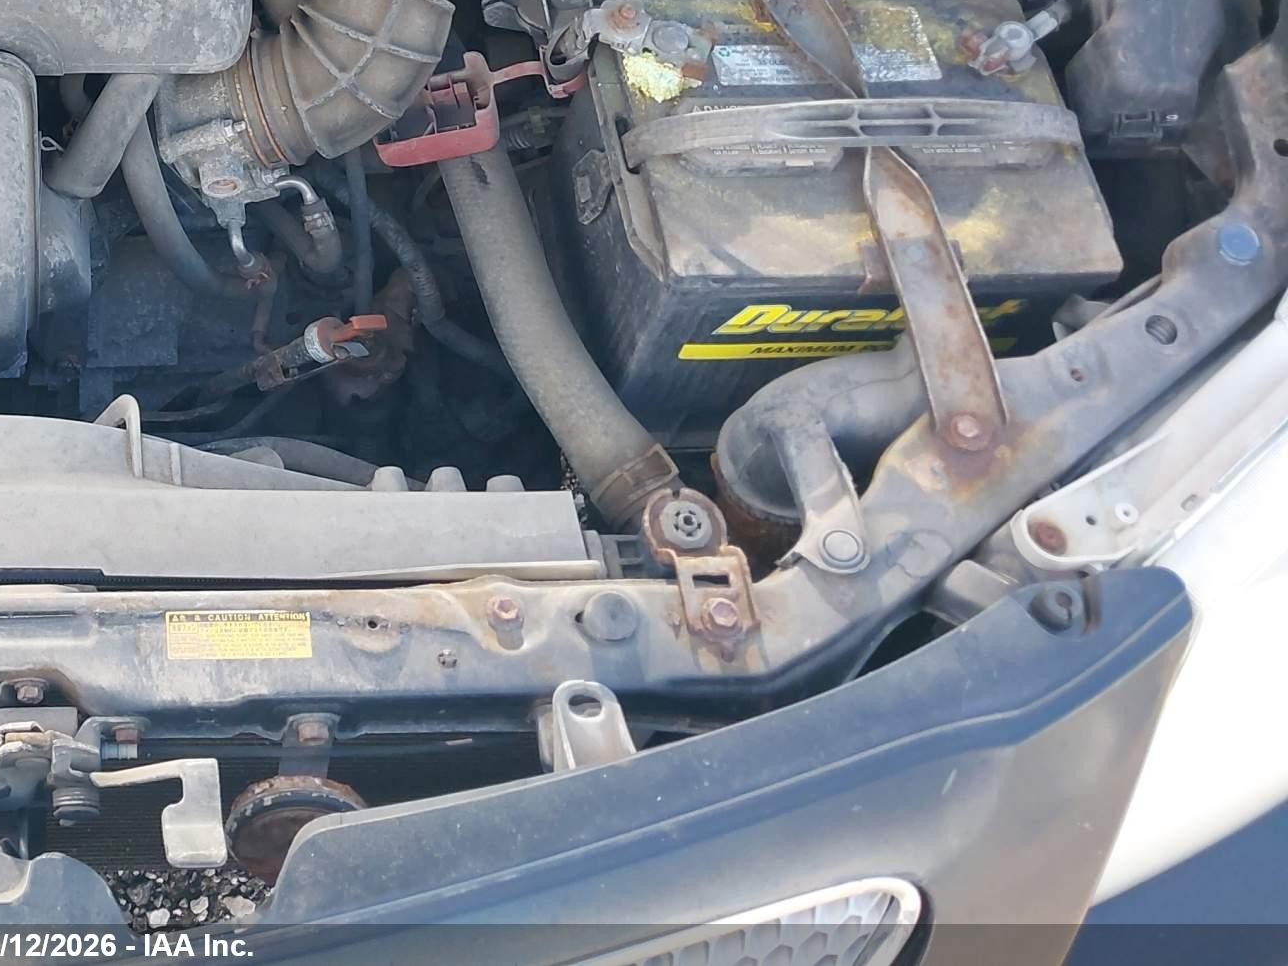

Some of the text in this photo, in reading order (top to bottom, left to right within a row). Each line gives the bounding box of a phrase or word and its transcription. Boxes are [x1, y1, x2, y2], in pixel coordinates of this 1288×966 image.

[711, 300, 1028, 335] Duralt
[750, 344, 856, 356] MAXIMUM
[208, 611, 307, 622] CAUTION ATTENTION
